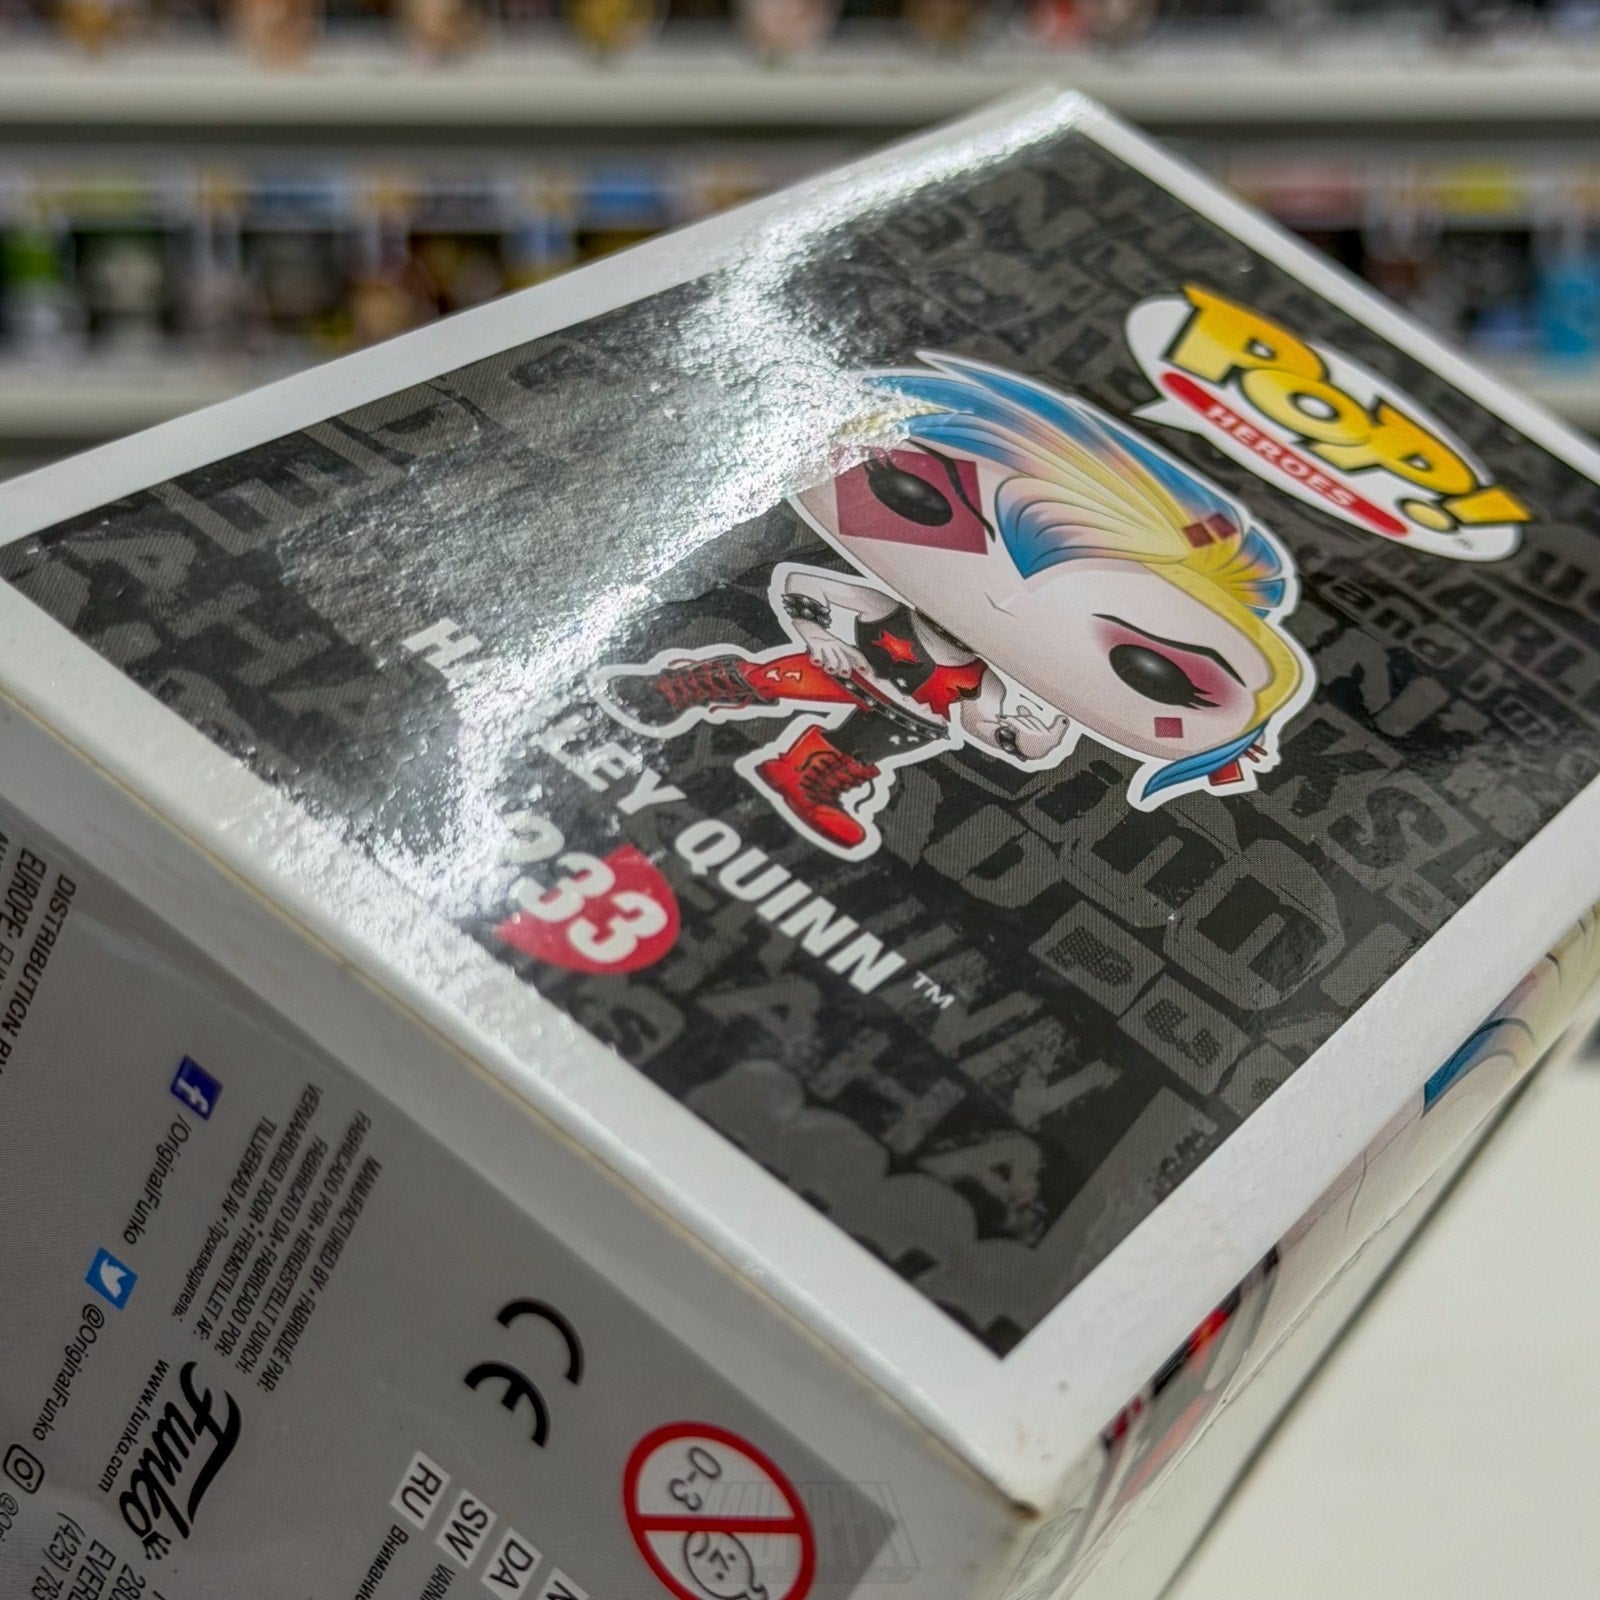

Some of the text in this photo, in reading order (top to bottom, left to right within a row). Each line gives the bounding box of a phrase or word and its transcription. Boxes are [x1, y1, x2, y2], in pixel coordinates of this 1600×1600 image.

[1163, 282, 1534, 533] POP!
[1207, 403, 1357, 507] HEROES
[403, 617, 687, 815] HLEY
[674, 818, 907, 994] QUINN
[2, 873, 77, 1037] DISTRIBUTION
[123, 1112, 193, 1246] /OriginalFunko
[193, 1083, 323, 1341] VERVAARDIGD DOOR FREMSTILLET AF:
[221, 1115, 277, 1221] TILLVERKAD AV
[171, 1219, 230, 1322] Производитель:
[214, 1134, 329, 1358] FABBRICATO DA FABRICADO POR:
[235, 1109, 372, 1376] FABRICADO POR HERGESTELLT DURCH:
[256, 1155, 383, 1393] MANUFACTURED BY FABRIQUÉ PAR:
[33, 1303, 105, 1442] @OriginalFunko
[98, 1358, 171, 1494] www.funko.com
[118, 1360, 242, 1540] Funko
[400, 1461, 443, 1520] RU
[668, 1446, 722, 1511] 0-3
[43, 1511, 86, 1572] (425)
[109, 1563, 146, 1600] 280
[445, 1499, 488, 1562] SW
[489, 1538, 534, 1590] DA
